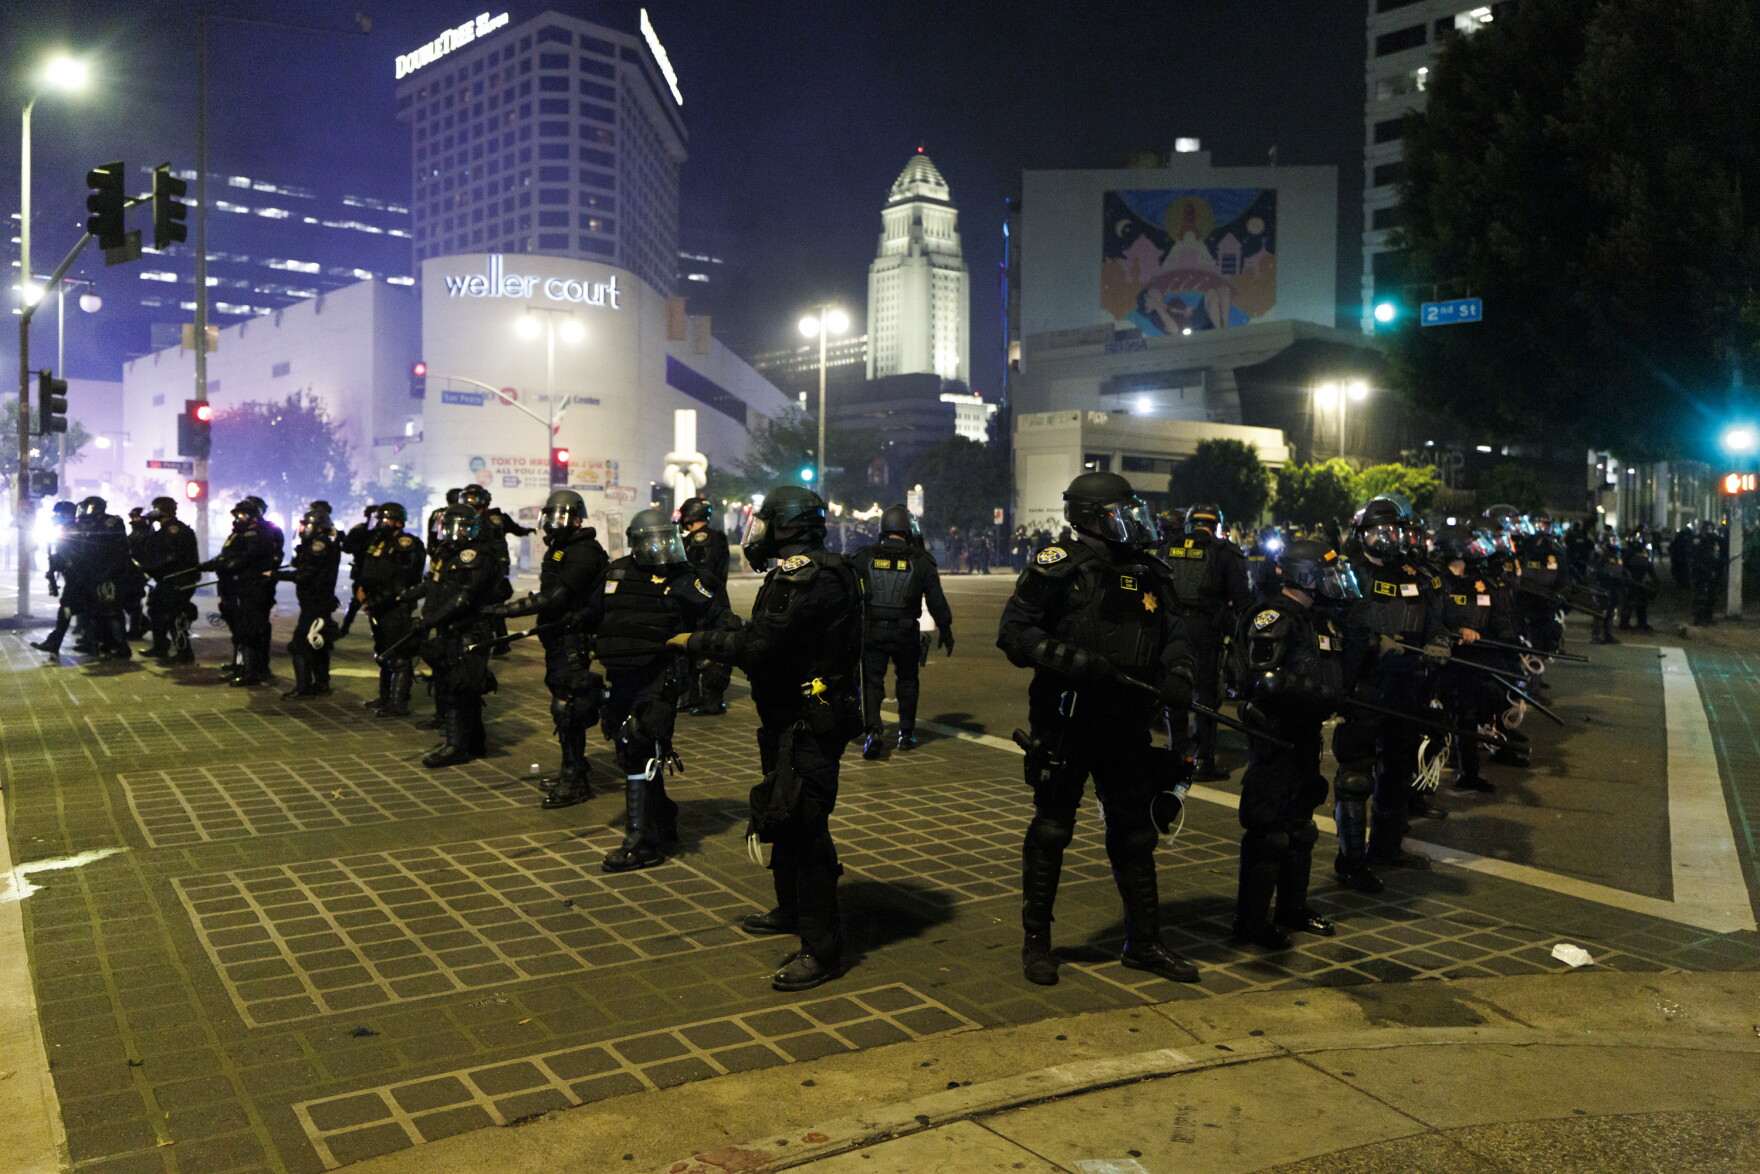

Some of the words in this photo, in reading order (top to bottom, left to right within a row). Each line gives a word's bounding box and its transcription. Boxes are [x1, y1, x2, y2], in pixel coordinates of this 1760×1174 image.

[445, 254, 540, 299] weller
[544, 275, 621, 309] court
[1427, 304, 1454, 321] 2nd
[1459, 304, 1476, 317] St
[490, 457, 527, 466] TOKYO
